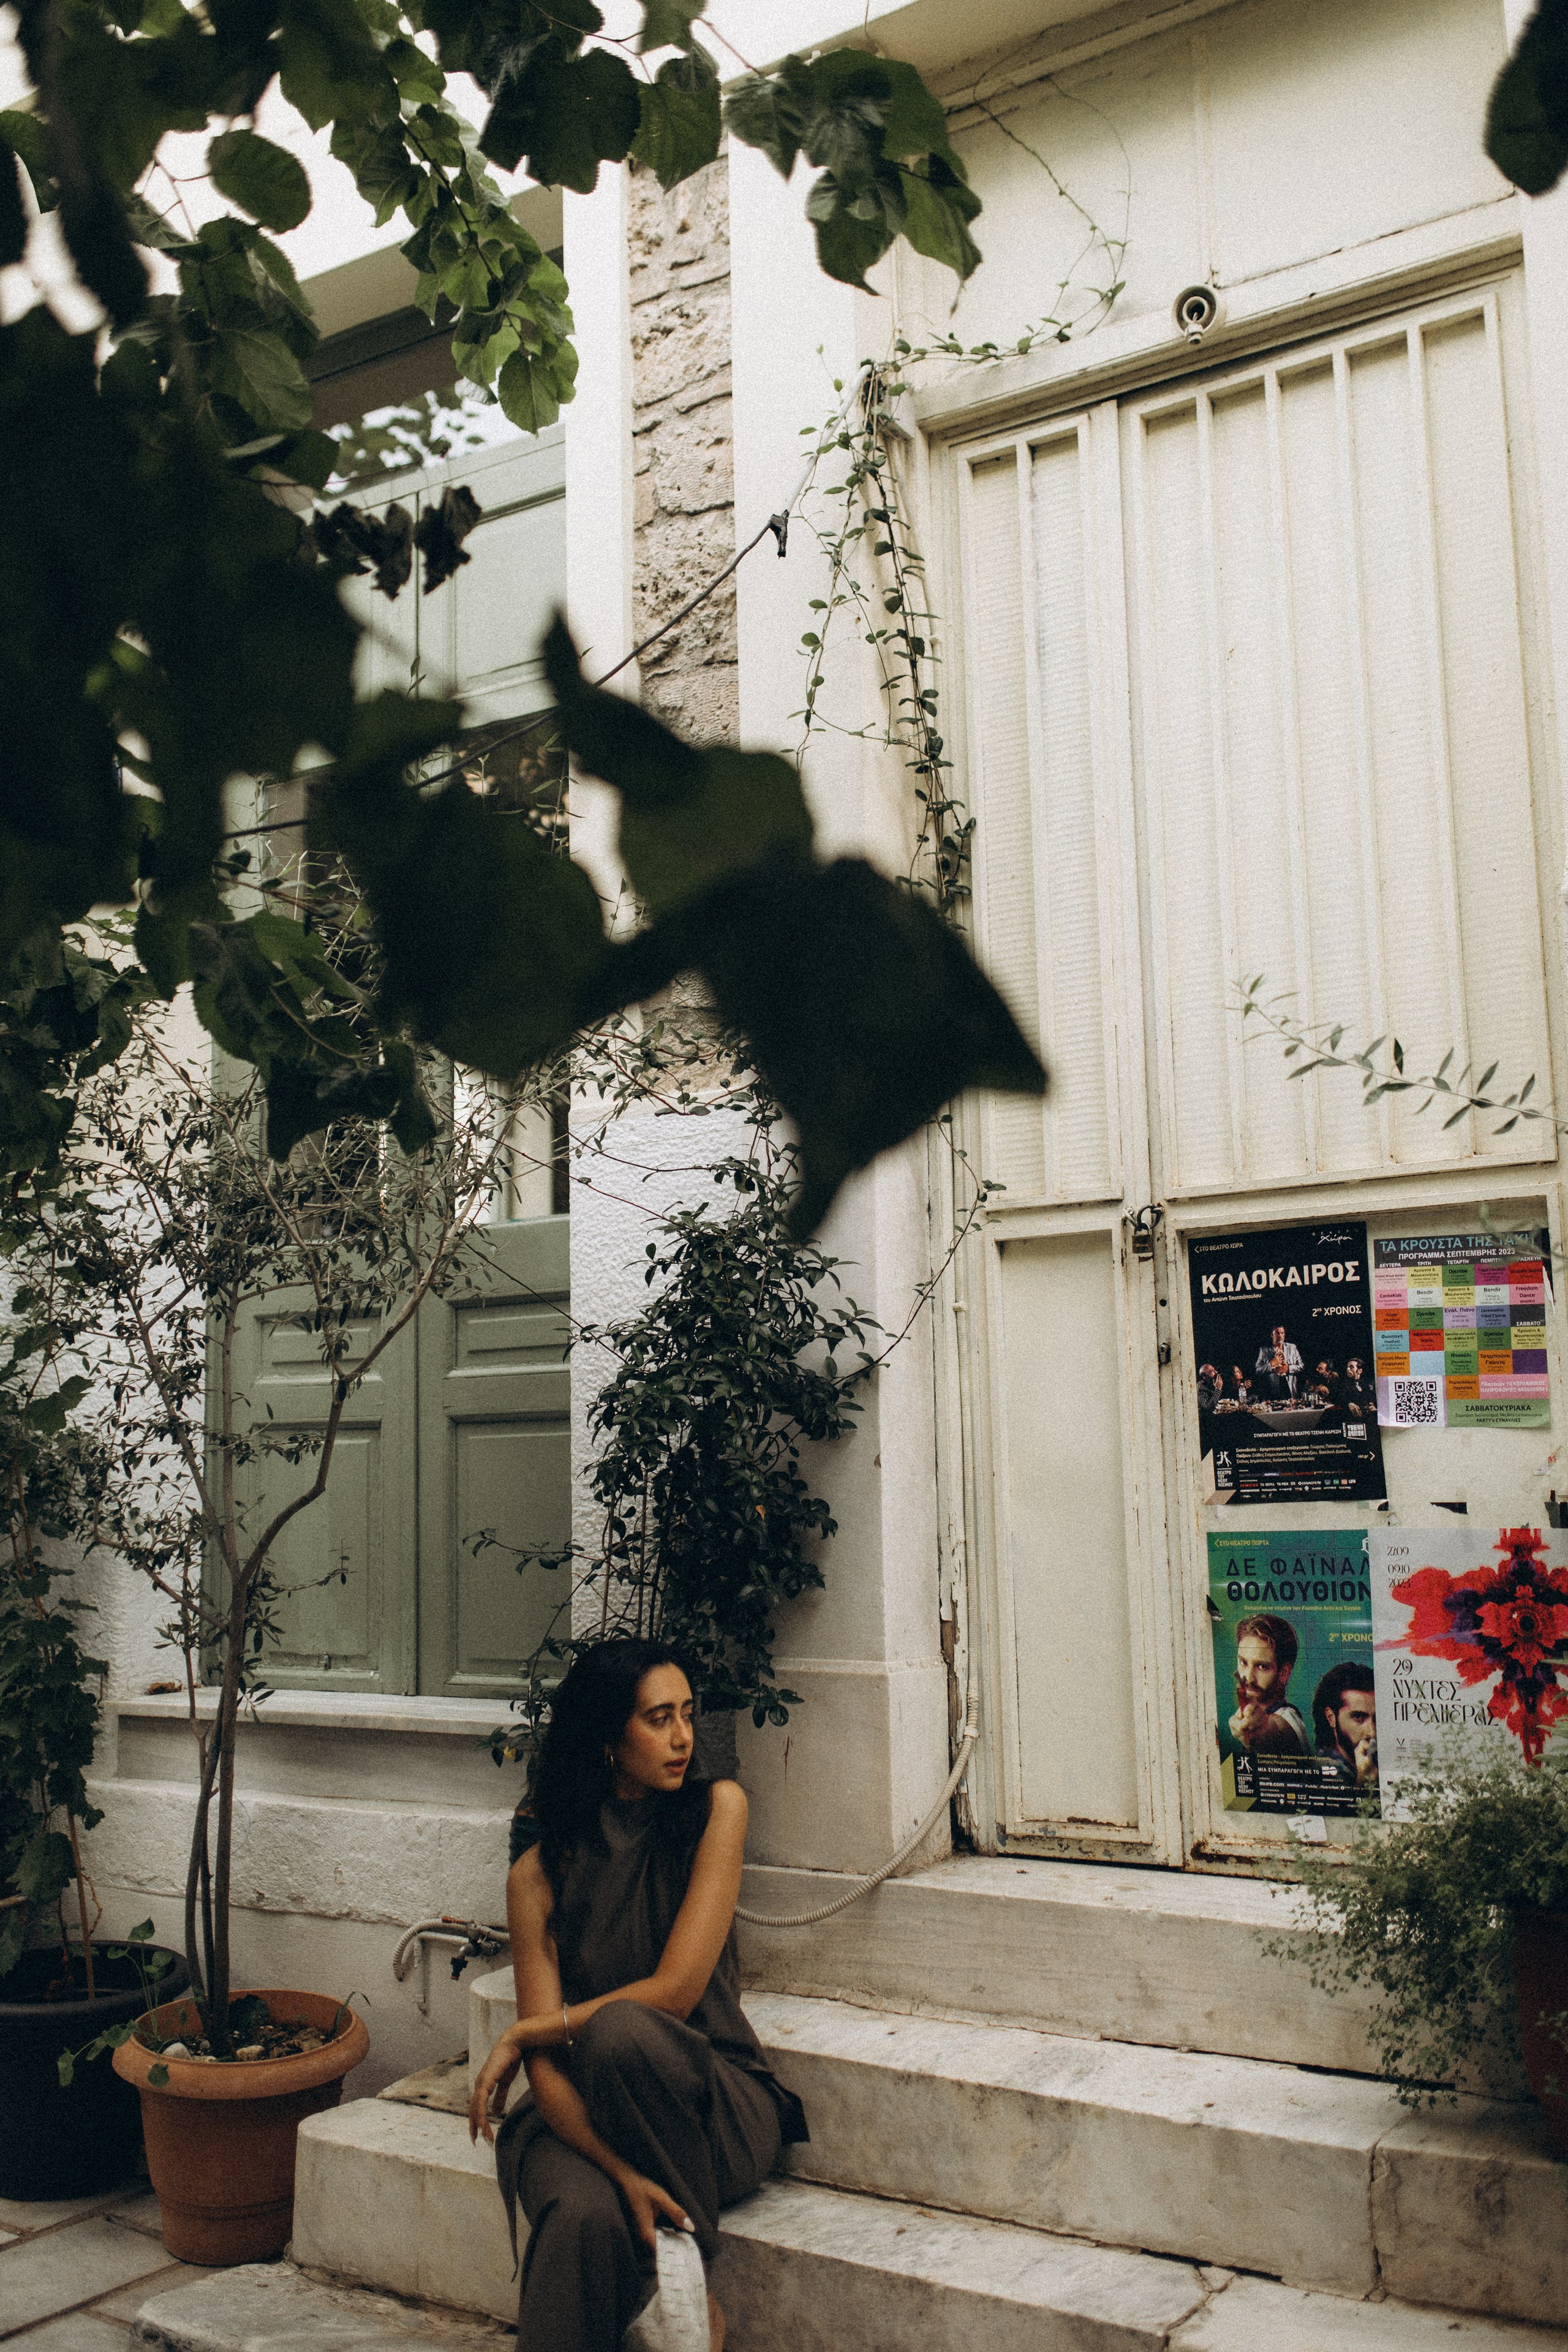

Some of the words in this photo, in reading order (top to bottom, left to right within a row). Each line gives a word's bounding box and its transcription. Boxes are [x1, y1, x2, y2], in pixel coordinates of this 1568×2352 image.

[1380, 1241, 1396, 1252] ΤΑ
[1400, 1237, 1463, 1251] ΚΡΟΥΣΤΑ
[1466, 1235, 1493, 1247] ΤΗΣ
[1447, 1249, 1496, 1257] ΣΕΠΤΕΜΒΡΗΣ
[1202, 1261, 1360, 1294] ΚΩΛΟΚΑΙΡΟΣ
[1324, 1305, 1362, 1316] ΧΡΟΝΟΣ
[1226, 1558, 1256, 1576] ΔΕ
[1388, 1564, 1410, 1574] 09.10
[1389, 1577, 1411, 1588] 2023
[1393, 1658, 1412, 1676] 29
[1393, 1679, 1461, 1701] ΝΥΧΤΕΣ
[1393, 1702, 1499, 1726] ΠΡΕΜΙΕΡΑΣ
